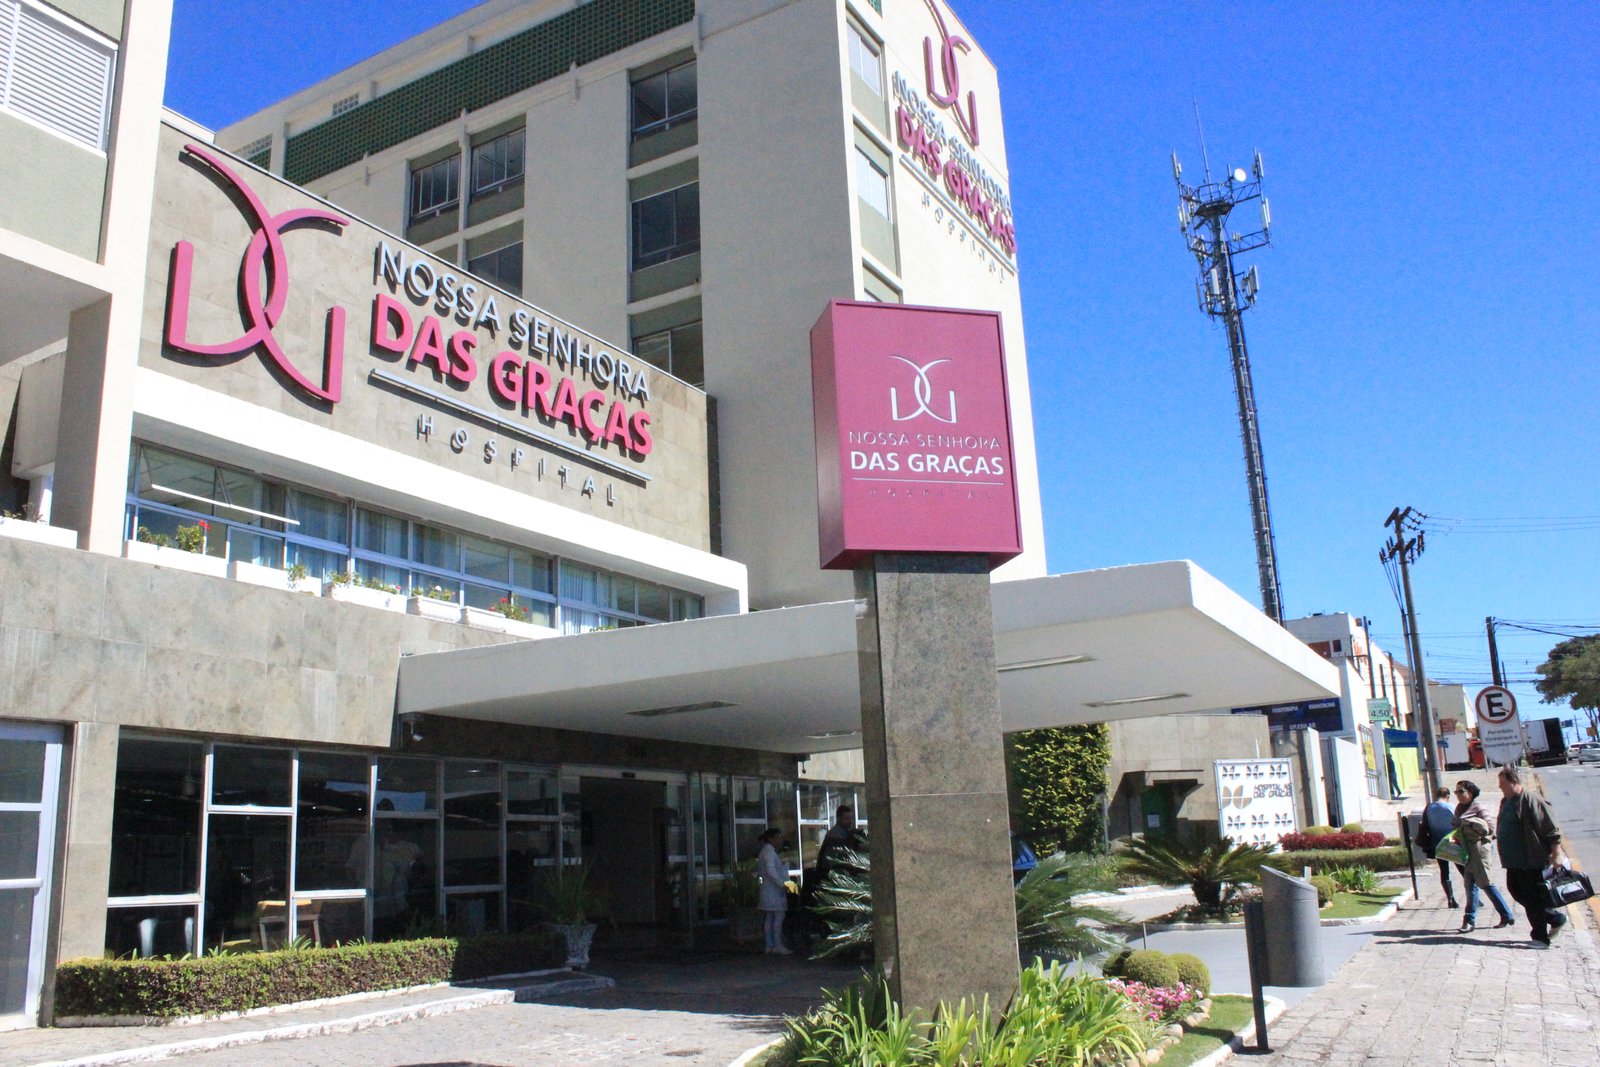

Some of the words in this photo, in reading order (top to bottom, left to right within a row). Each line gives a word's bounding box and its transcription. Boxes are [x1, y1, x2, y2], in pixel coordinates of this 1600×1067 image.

[894, 71, 947, 147] NOSSA
[897, 106, 942, 175] DAS
[377, 241, 501, 333] NOSSA
[511, 308, 651, 401] SENHORA
[374, 293, 478, 382] DAS
[492, 351, 652, 455] GRAÇAS
[417, 413, 618, 504] HOSPITAL
[849, 432, 910, 446] NOSSA
[916, 434, 1001, 450] SENHORA
[850, 451, 900, 471] DAS
[907, 453, 1005, 477] GRAÇAS
[1370, 709, 1390, 718] 4,50
[1485, 693, 1507, 717] E
